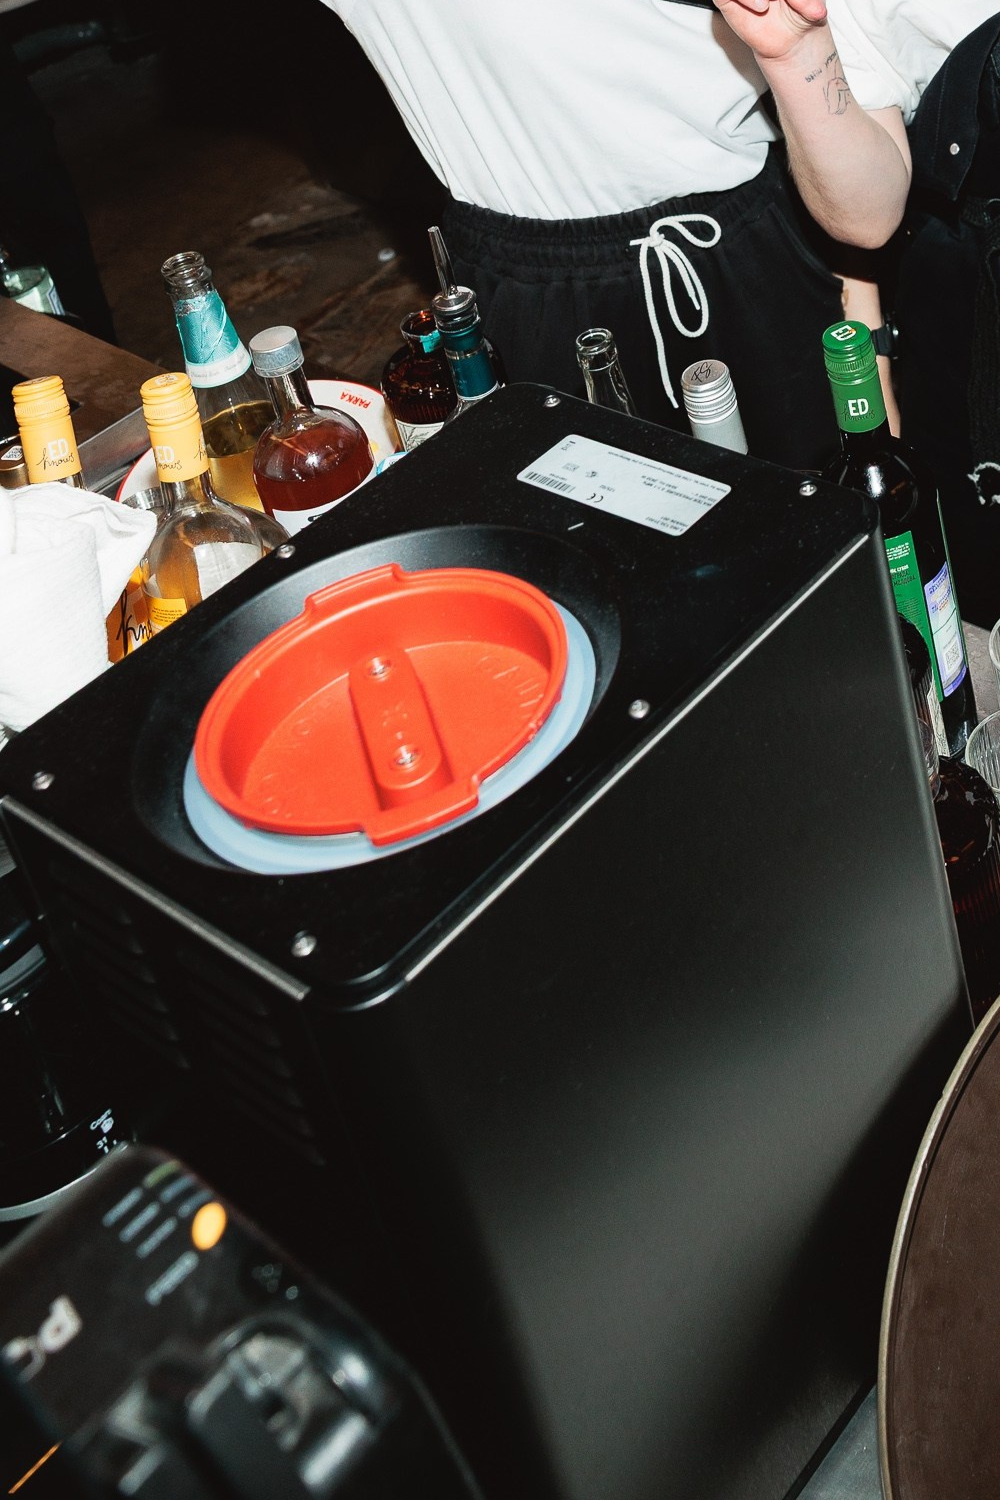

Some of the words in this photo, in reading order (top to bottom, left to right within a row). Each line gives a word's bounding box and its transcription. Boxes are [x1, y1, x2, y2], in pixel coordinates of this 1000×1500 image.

[848, 398, 869, 417] ED
[36, 447, 75, 471] knows
[49, 438, 69, 461] ED
